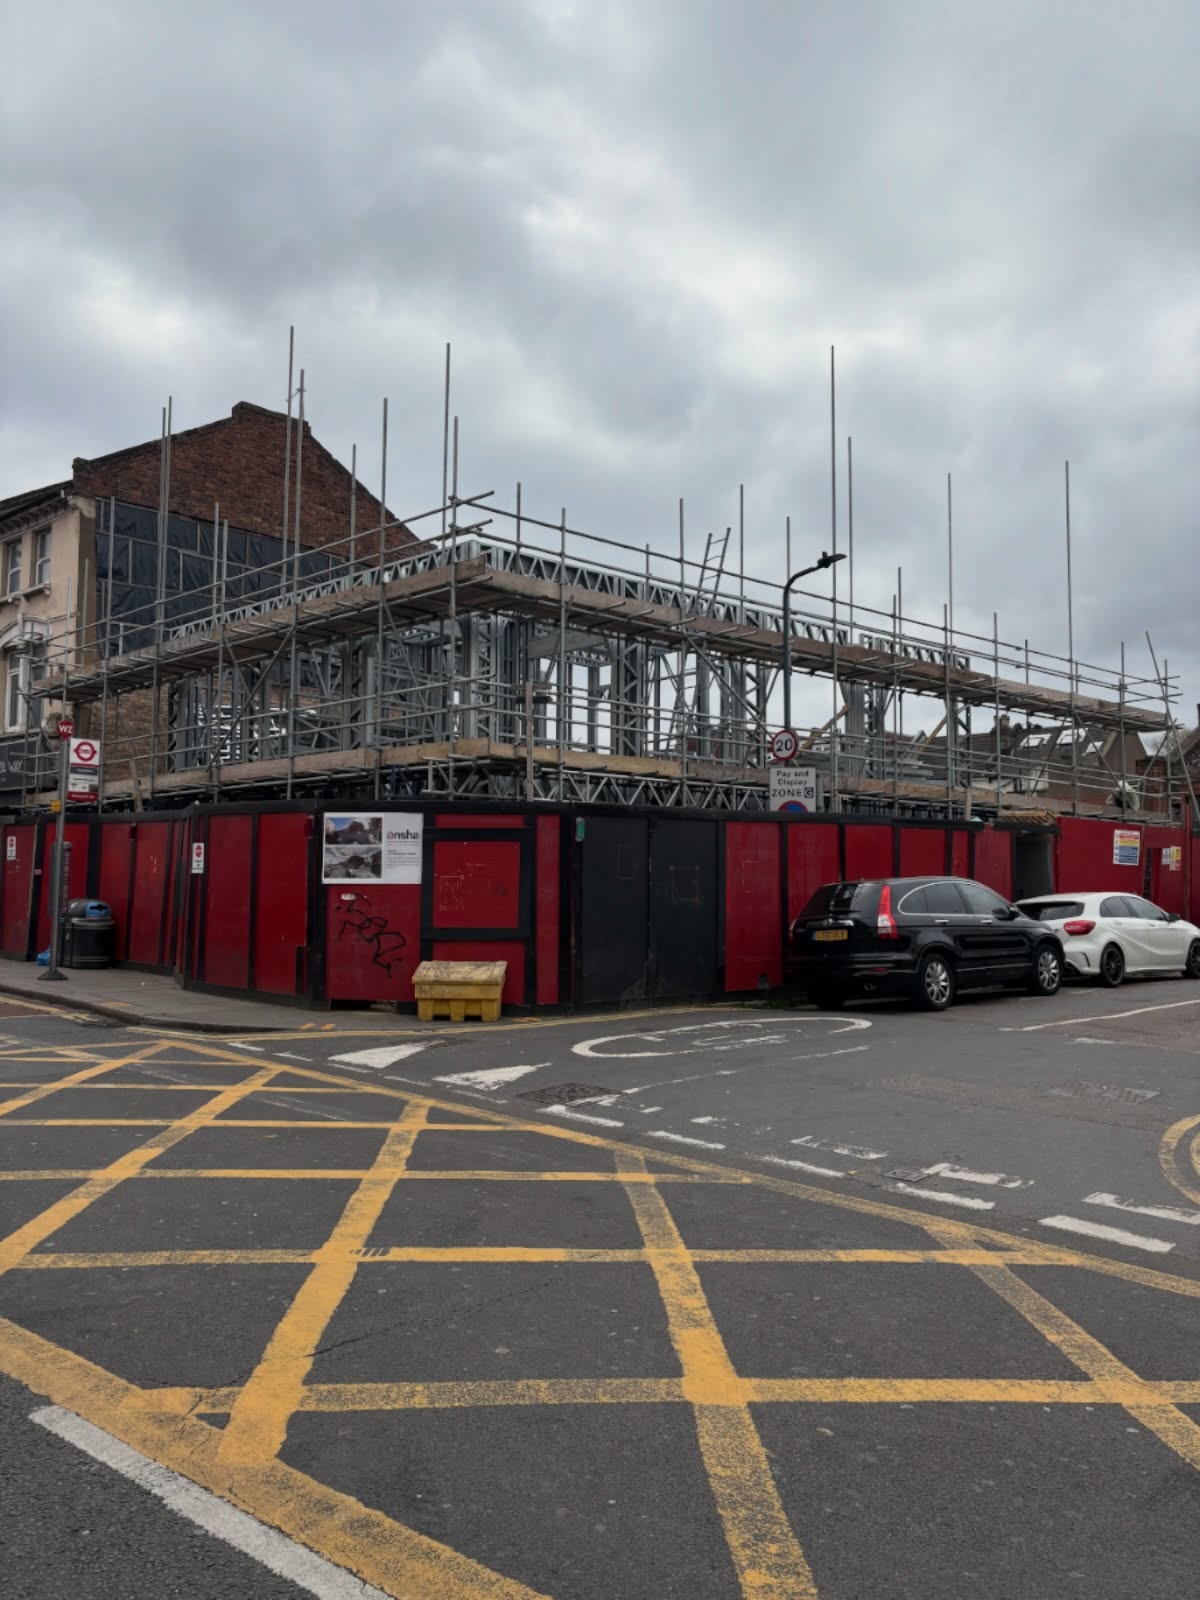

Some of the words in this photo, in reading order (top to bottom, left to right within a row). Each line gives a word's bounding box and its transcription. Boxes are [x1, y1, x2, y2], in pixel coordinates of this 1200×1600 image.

[775, 739, 793, 752] 20
[777, 770, 791, 778] Pay
[772, 788, 802, 797] ZONE
